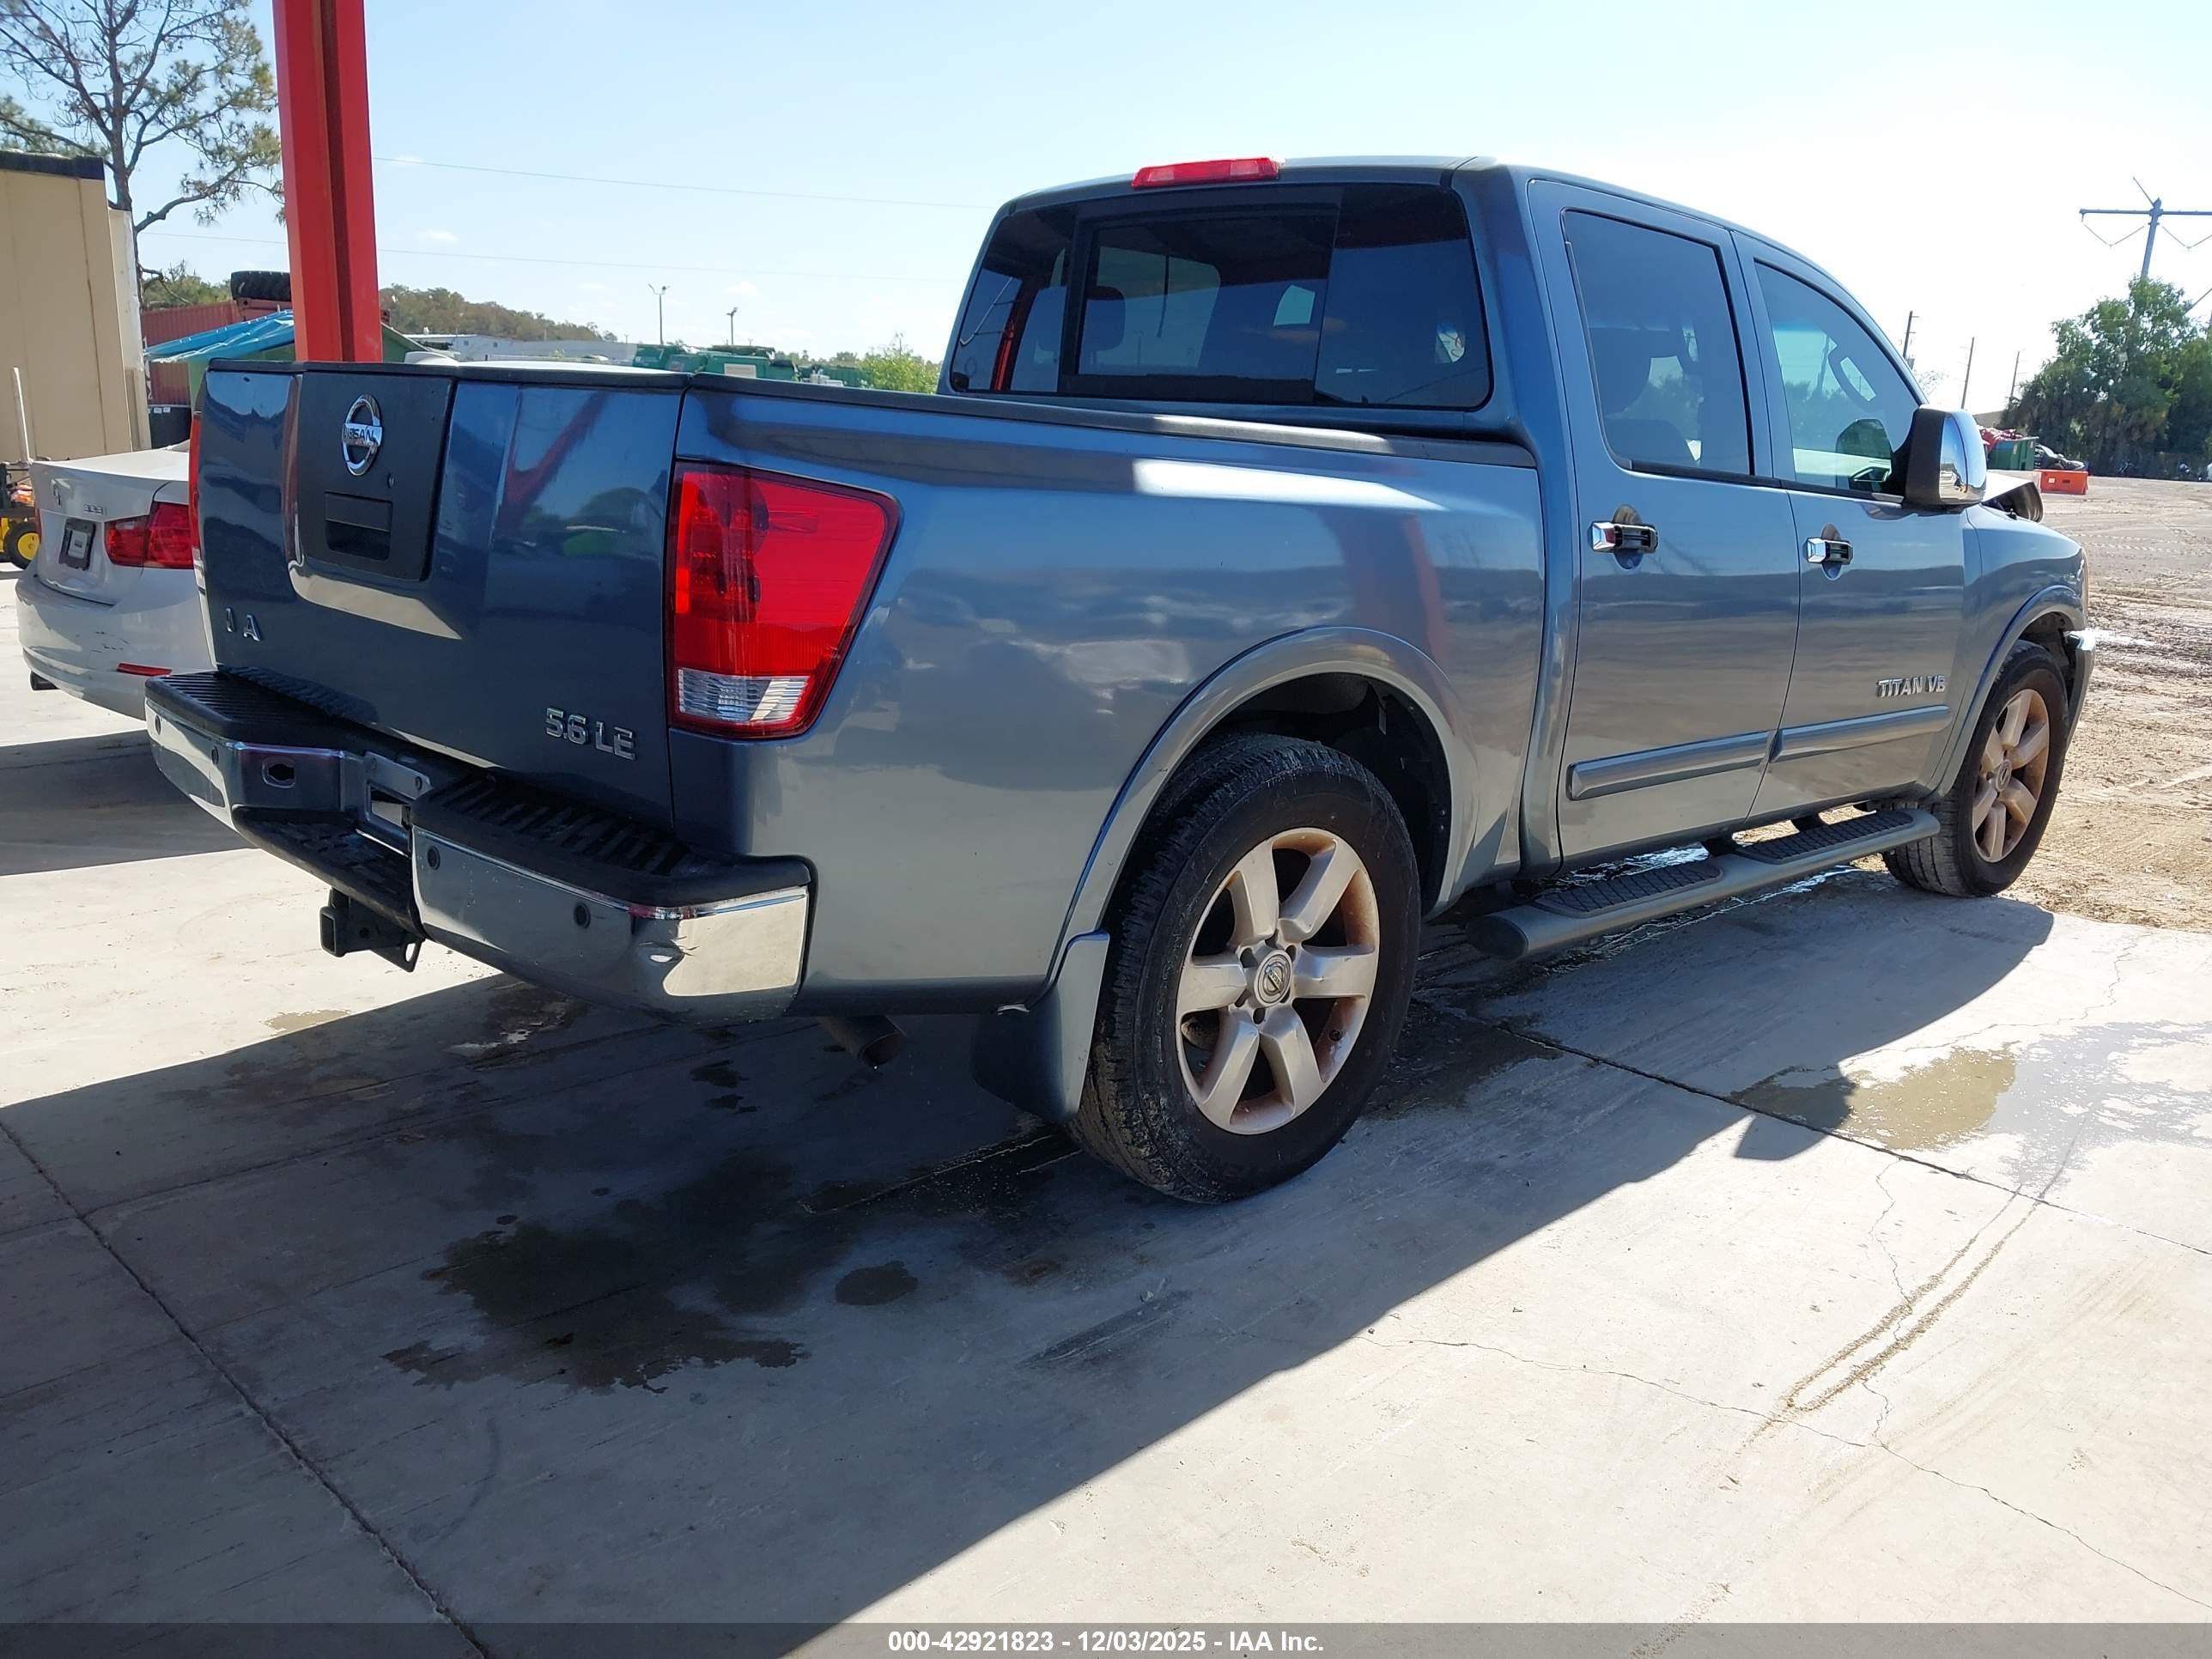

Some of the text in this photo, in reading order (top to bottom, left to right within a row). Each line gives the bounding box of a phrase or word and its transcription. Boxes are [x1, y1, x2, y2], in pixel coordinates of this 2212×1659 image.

[1877, 674, 1946, 698] TITAN V8
[545, 708, 635, 761] 5.6 LE
